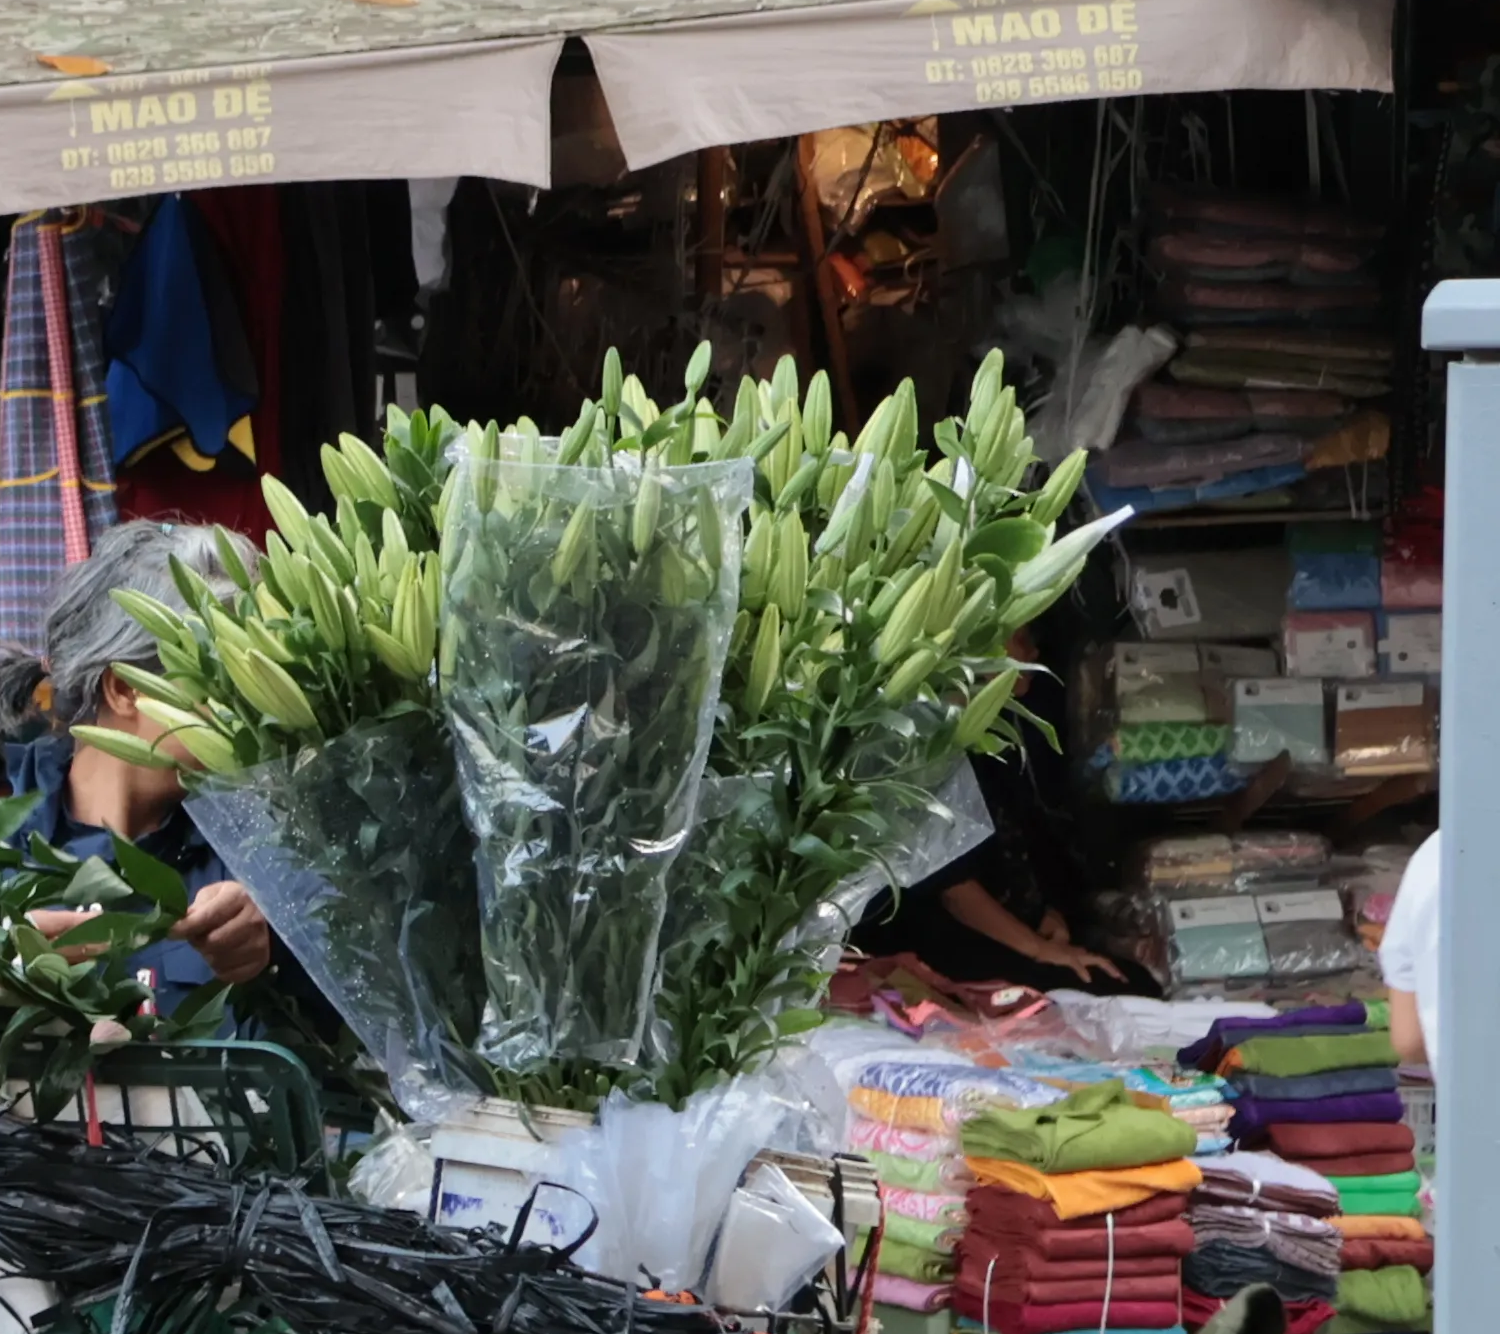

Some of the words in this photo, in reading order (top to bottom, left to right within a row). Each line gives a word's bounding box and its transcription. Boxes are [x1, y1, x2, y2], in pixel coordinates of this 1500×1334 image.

[952, 8, 1061, 46] MAO
[90, 91, 197, 133] MAO
[212, 78, 272, 122] ĐỆ
